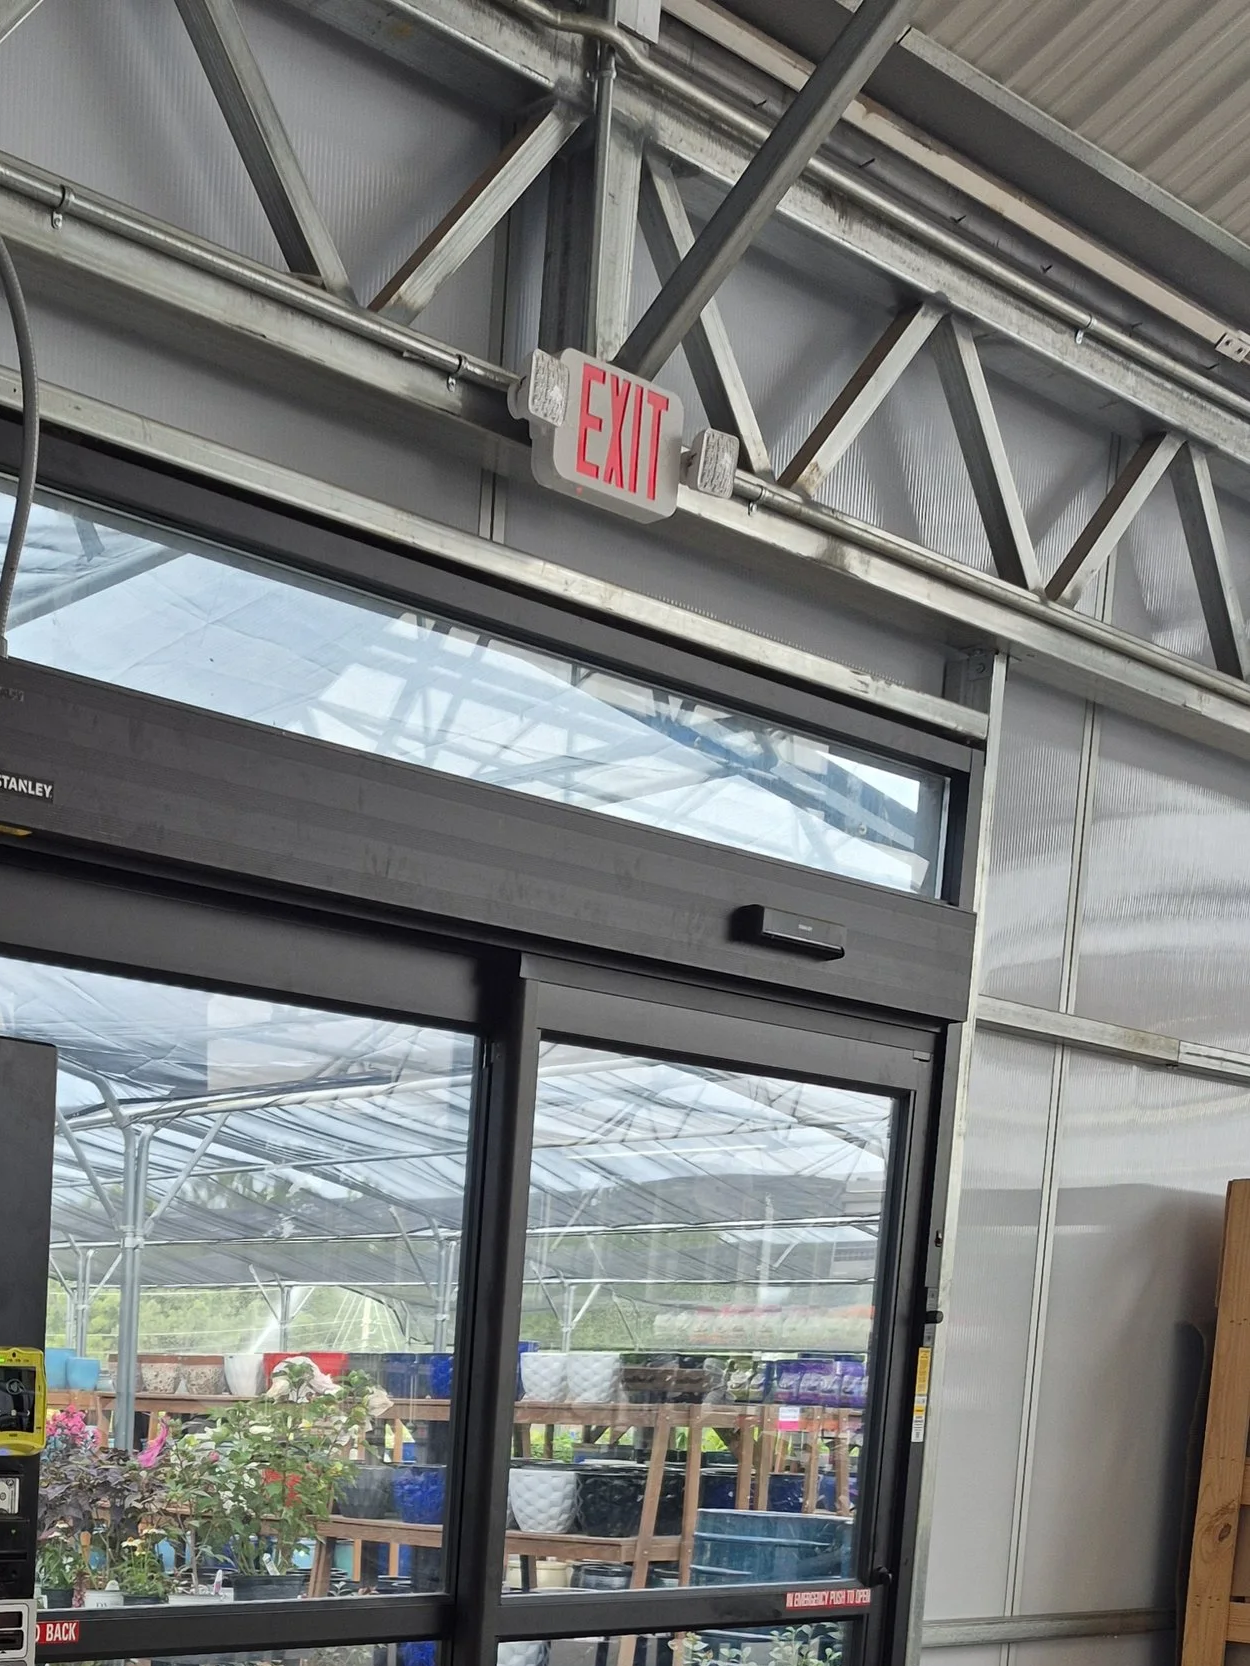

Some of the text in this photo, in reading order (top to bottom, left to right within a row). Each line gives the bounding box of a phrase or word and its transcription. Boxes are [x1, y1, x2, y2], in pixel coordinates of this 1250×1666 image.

[576, 362, 669, 501] EXIT
[830, 1590, 846, 1605] PUSH
[46, 1623, 77, 1642] BACK
